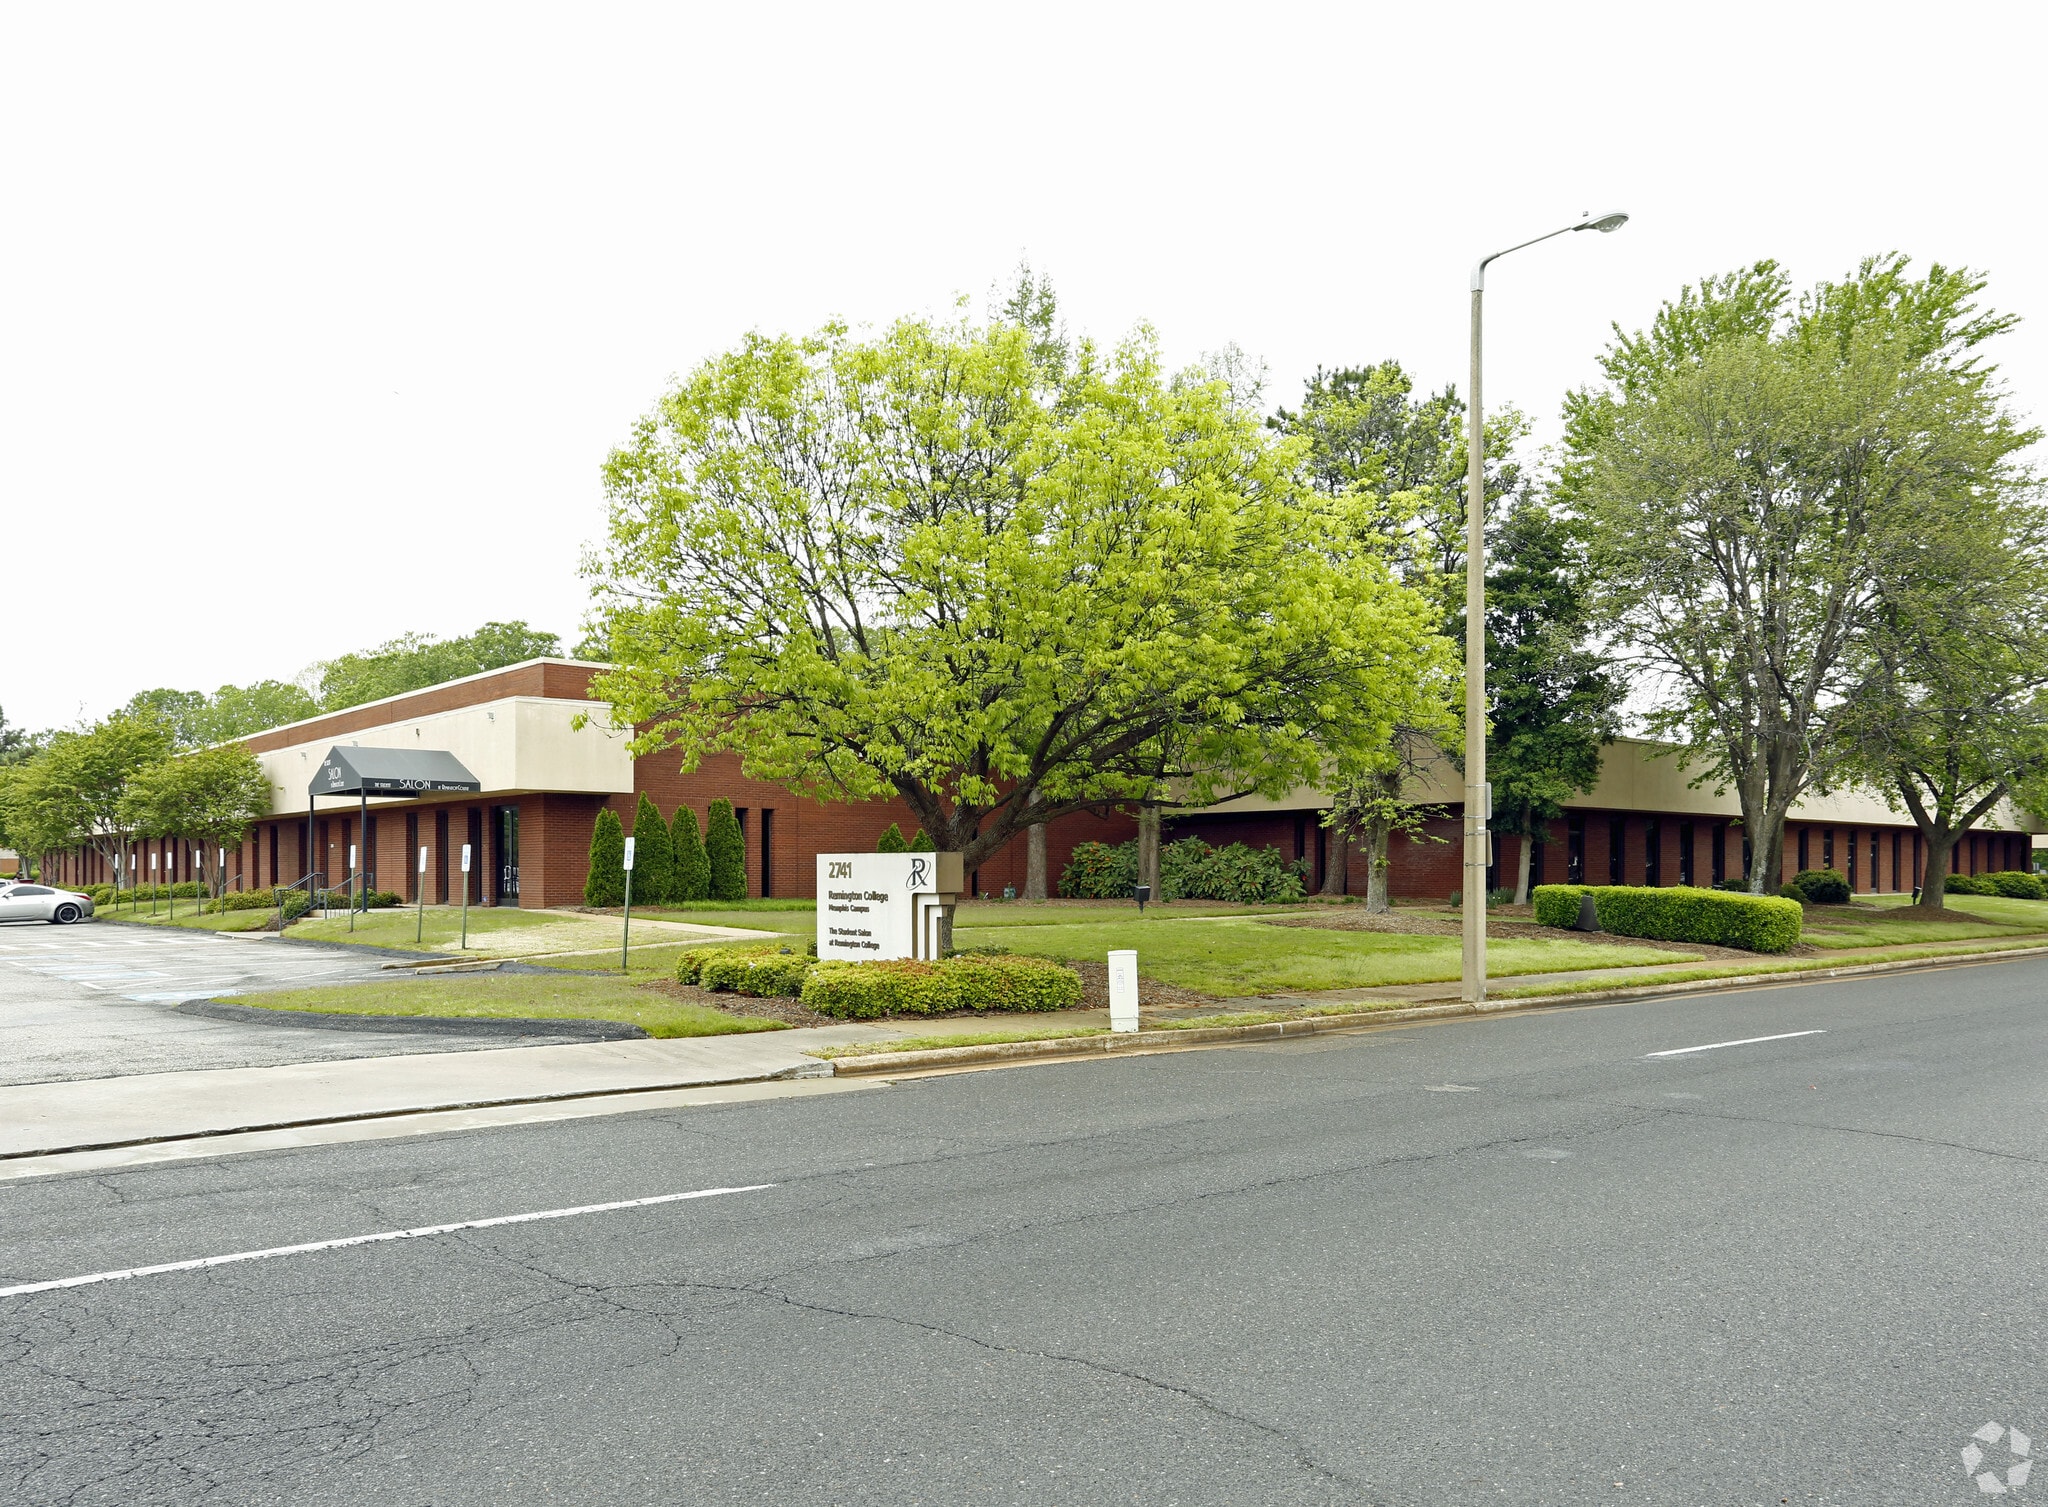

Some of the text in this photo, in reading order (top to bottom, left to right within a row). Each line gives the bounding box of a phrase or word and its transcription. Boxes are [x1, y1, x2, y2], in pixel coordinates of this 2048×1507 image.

[399, 778, 431, 790] SALON
[829, 861, 852, 879] 2741
[829, 890, 889, 903] Remington College
[829, 904, 870, 913] Memphis Campus
[829, 927, 872, 937] The Student Salon
[835, 939, 860, 949] Remington
[861, 940, 880, 951] College
